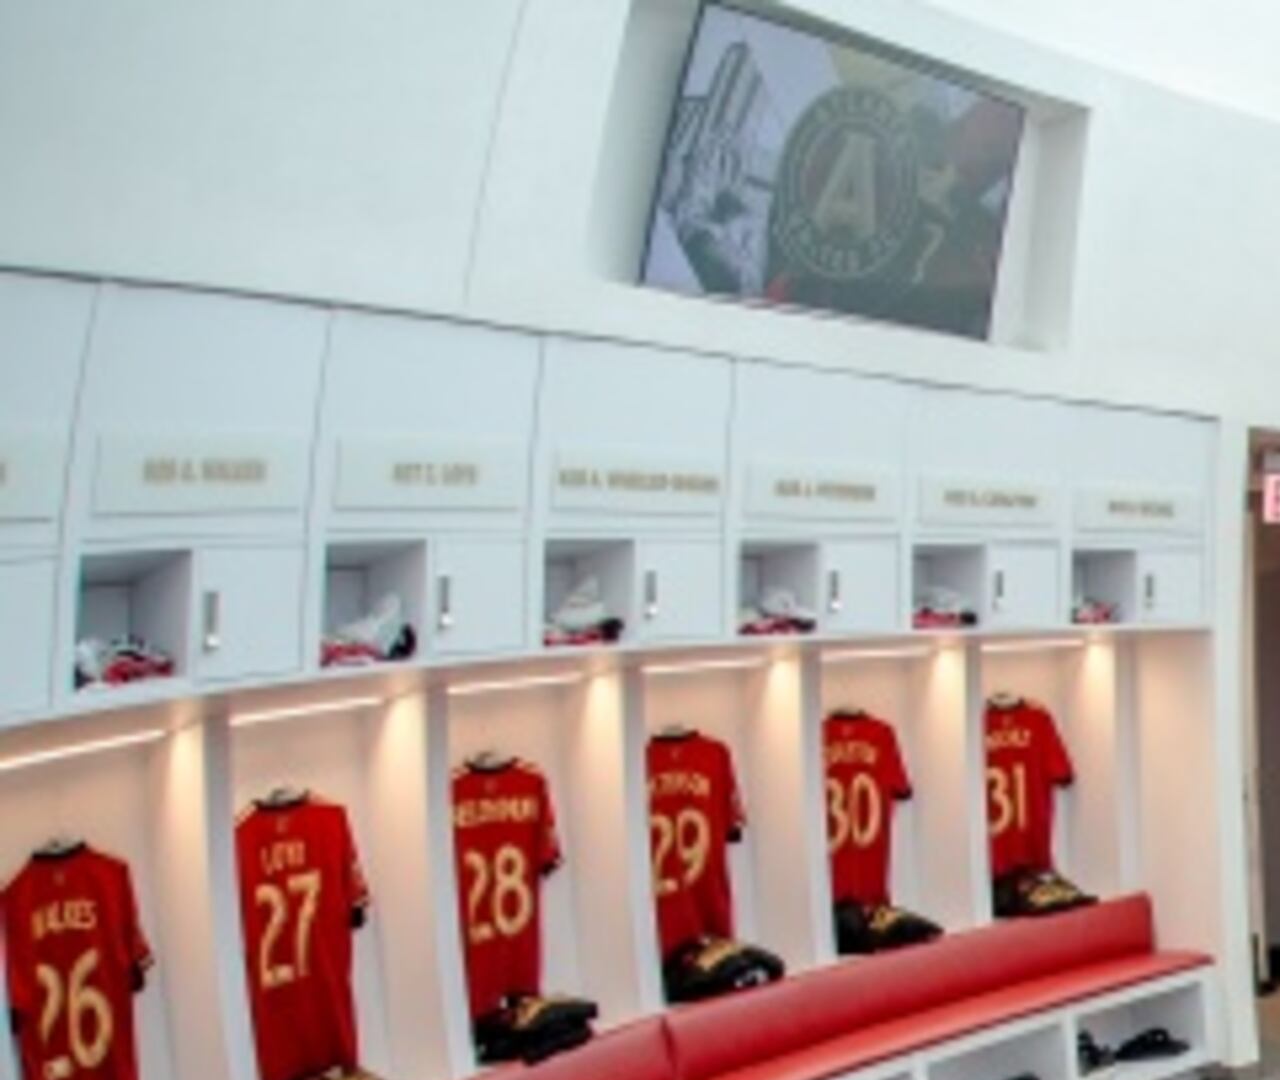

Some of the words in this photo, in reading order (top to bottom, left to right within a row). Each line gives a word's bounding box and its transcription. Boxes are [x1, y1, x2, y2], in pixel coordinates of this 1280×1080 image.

[826, 772, 883, 851] 30
[988, 762, 1028, 836] 31
[463, 845, 533, 943] 28
[652, 809, 711, 895] 29
[254, 869, 323, 989] 27
